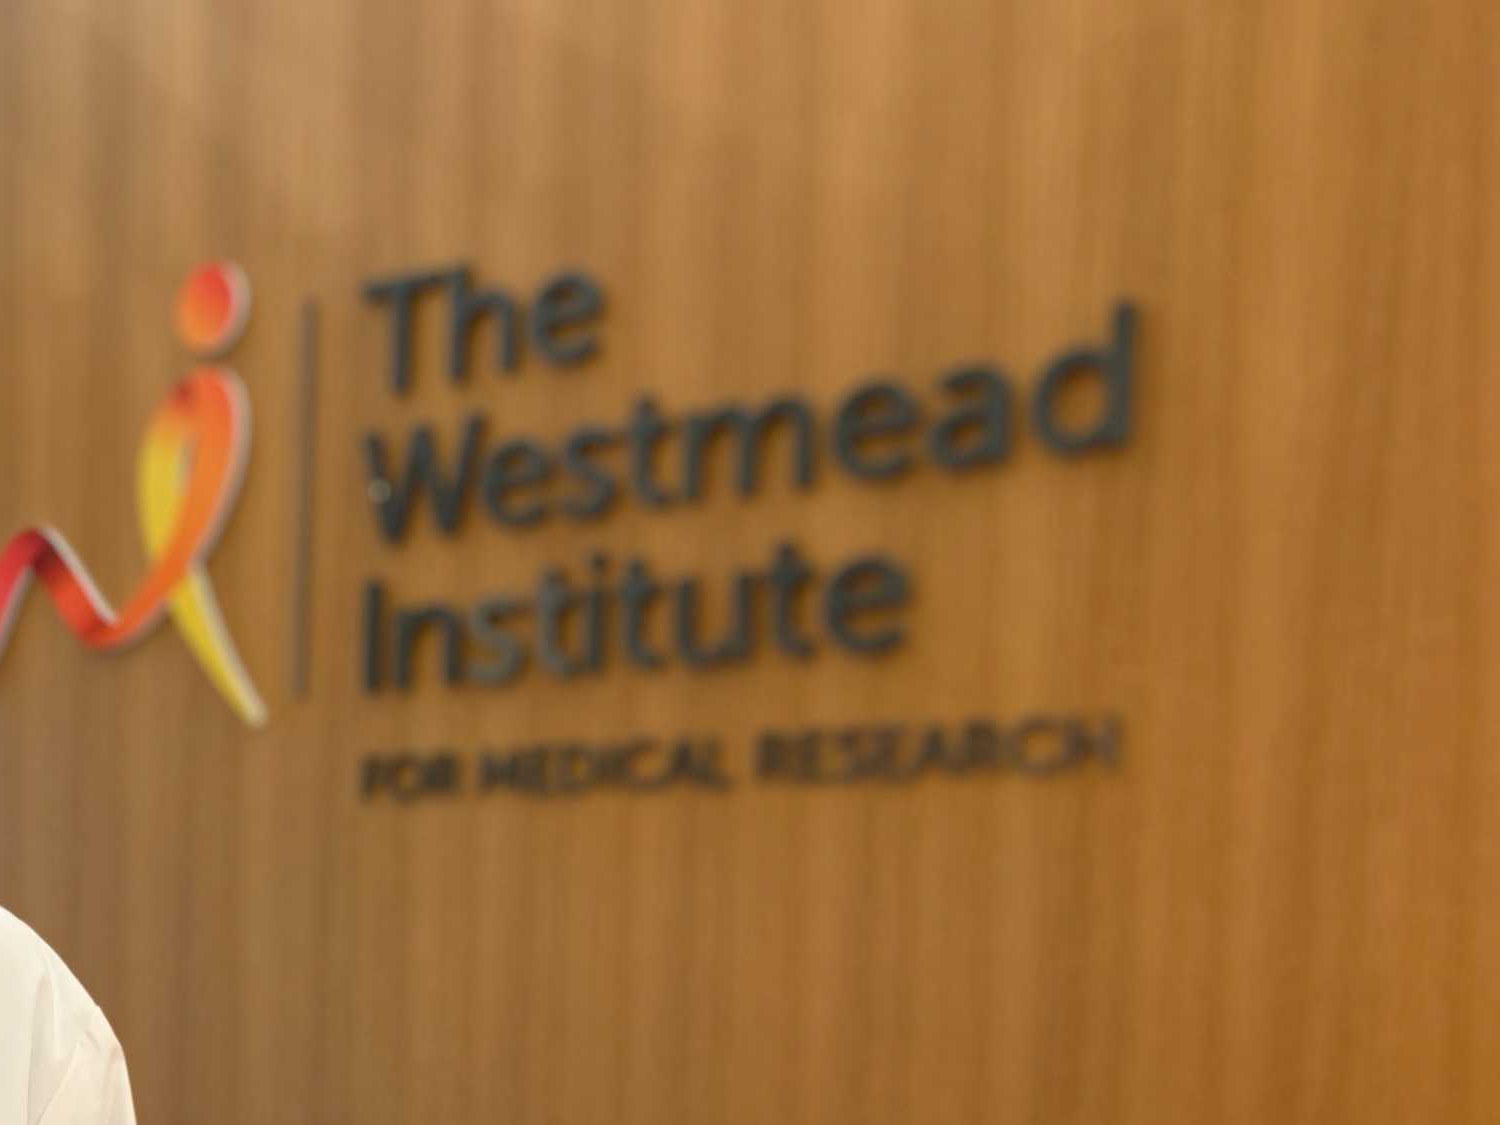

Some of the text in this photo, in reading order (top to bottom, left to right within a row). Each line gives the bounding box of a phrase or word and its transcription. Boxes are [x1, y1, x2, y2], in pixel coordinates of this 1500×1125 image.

[362, 266, 605, 396] The
[363, 296, 1140, 547] Westmead
[362, 540, 912, 695] Institute
[361, 714, 1123, 802] FOR MEDICAL RESEARCH
